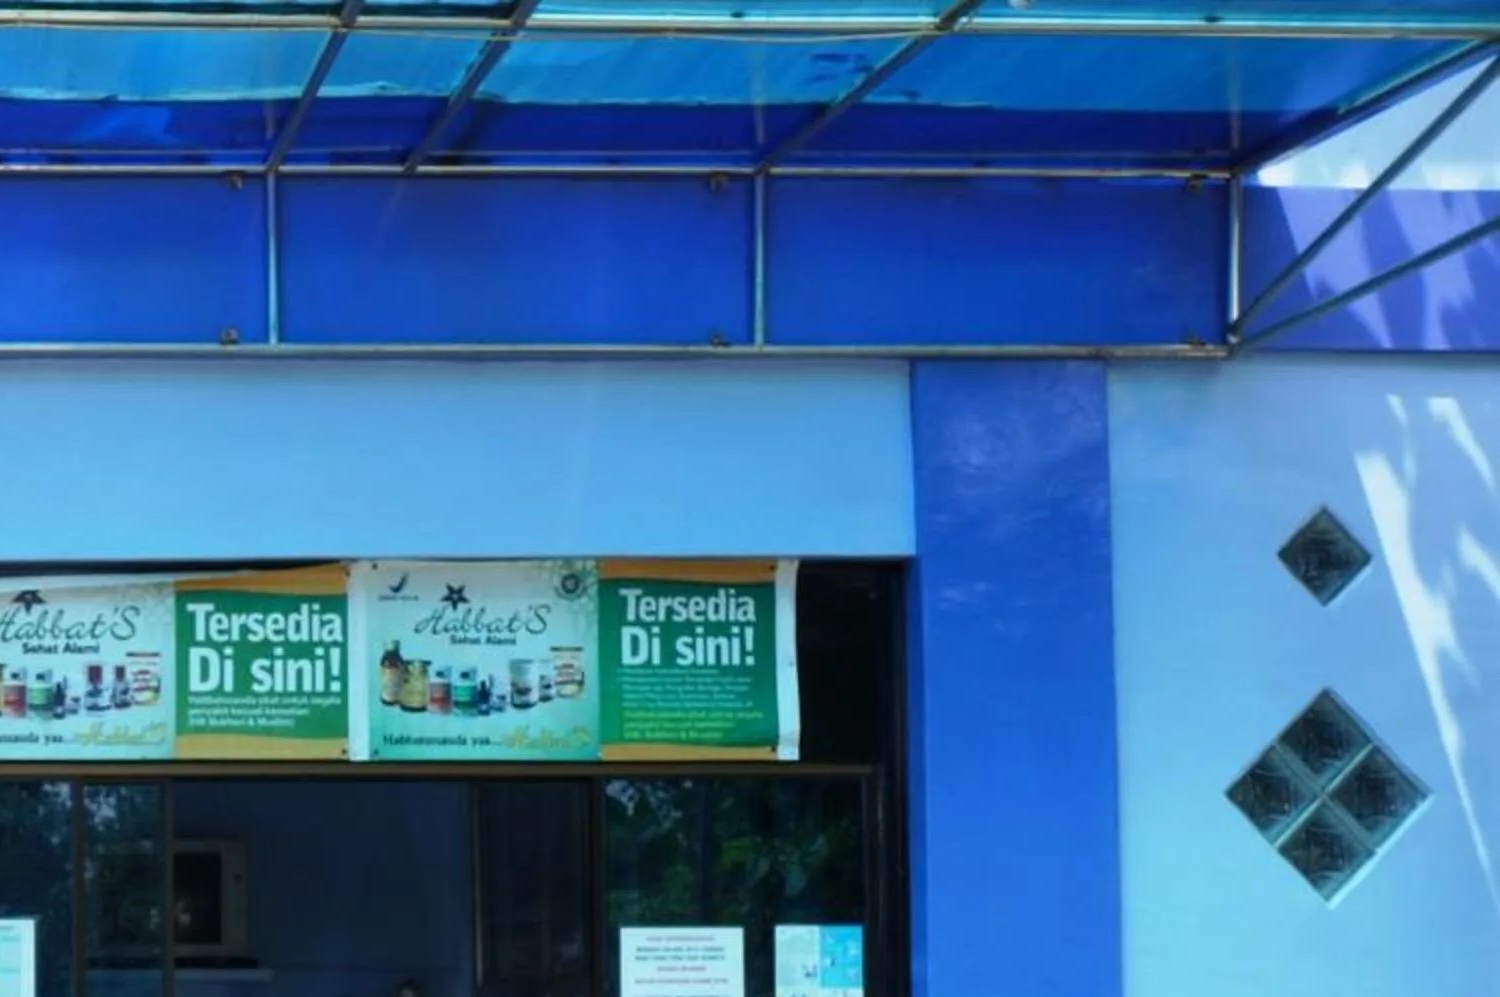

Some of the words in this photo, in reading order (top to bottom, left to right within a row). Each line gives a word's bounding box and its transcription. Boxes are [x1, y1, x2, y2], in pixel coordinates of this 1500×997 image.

[186, 602, 343, 642] Tersedia
[414, 604, 552, 635] Habbat'S
[619, 588, 756, 623] Tersedia
[621, 627, 661, 666] Di
[675, 626, 756, 667] sini!
[189, 648, 233, 692] Di
[251, 647, 342, 693] sini!
